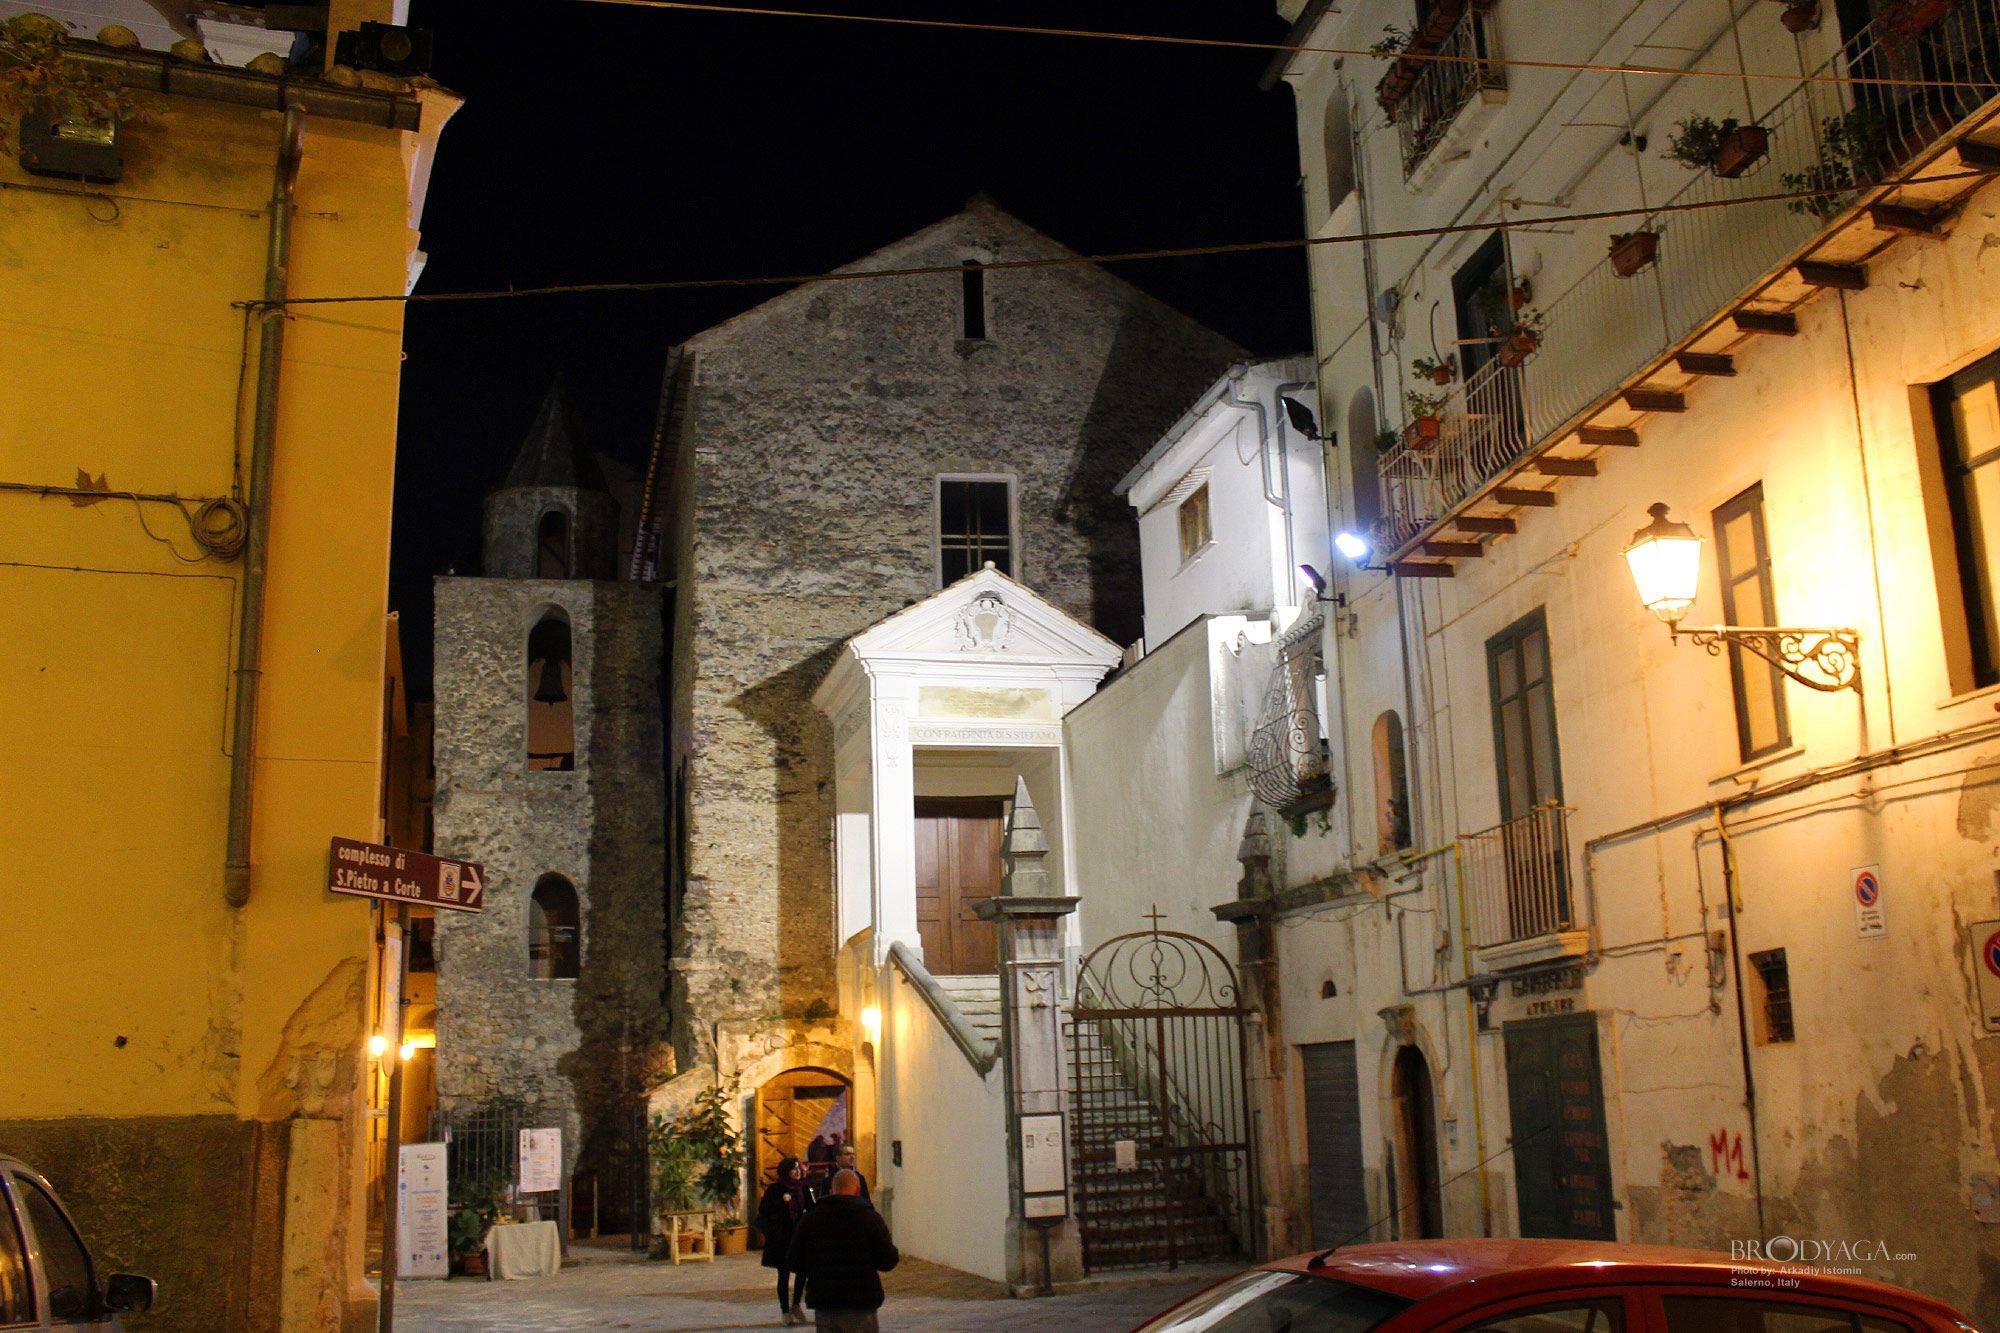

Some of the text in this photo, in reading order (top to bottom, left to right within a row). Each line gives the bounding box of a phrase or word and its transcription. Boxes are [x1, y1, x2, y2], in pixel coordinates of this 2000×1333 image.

[338, 846, 406, 870] complesso di
[336, 868, 421, 898] S.Pietro a Corte
